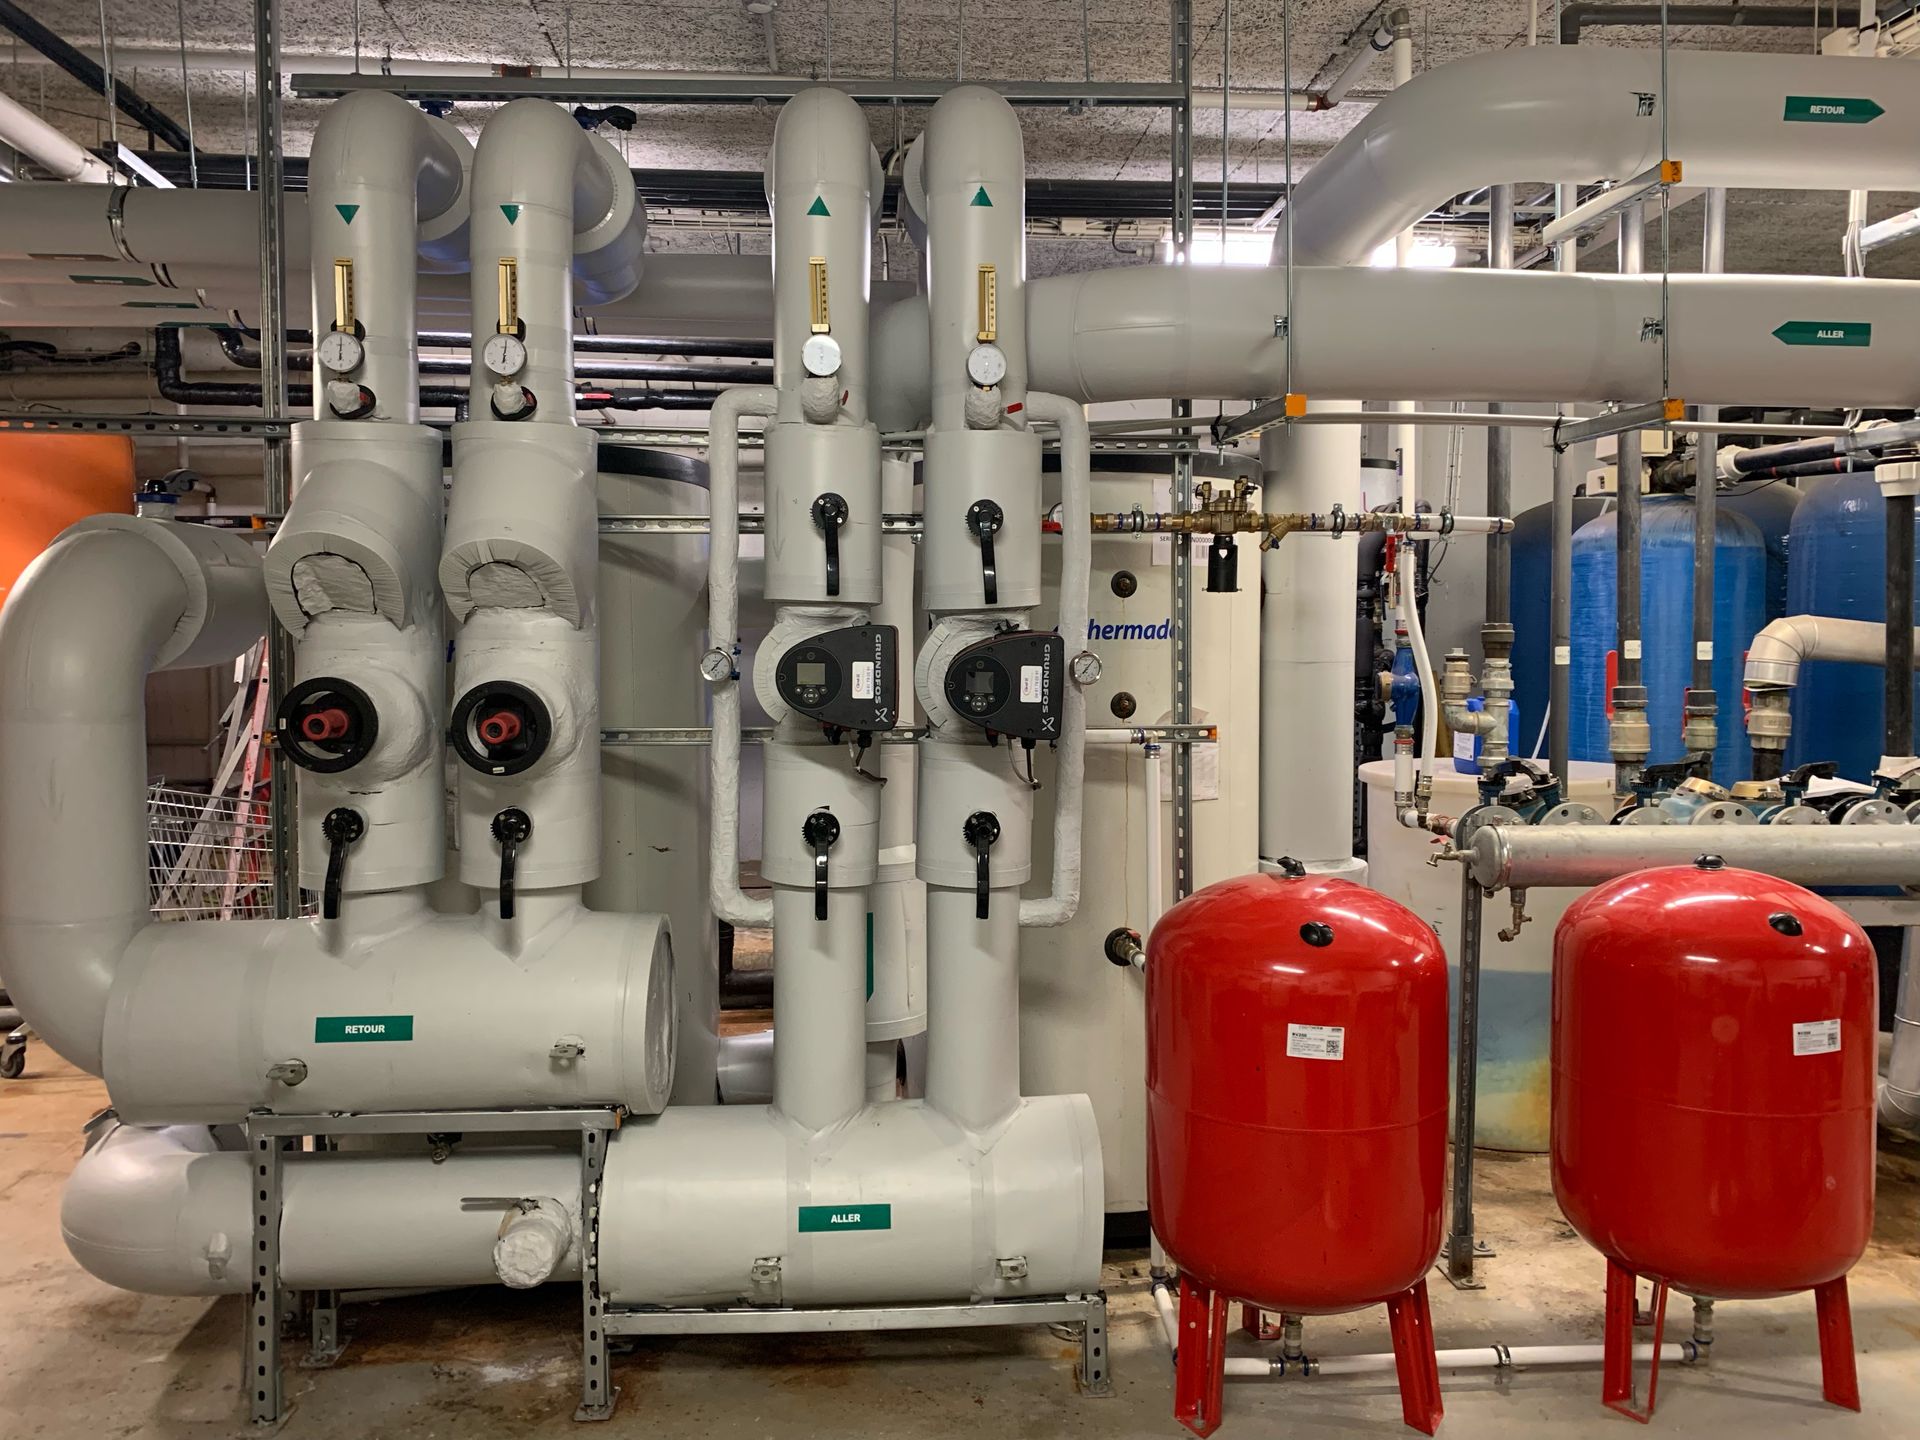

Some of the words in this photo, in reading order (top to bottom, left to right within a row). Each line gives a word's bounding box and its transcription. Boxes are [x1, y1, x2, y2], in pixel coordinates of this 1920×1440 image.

[1810, 105, 1845, 114] RETOUR
[1817, 330, 1844, 338] ALLER
[1087, 618, 1174, 640] hermad
[1042, 644, 1050, 713] GRUNDFOS
[345, 1024, 385, 1034] RETOUR
[830, 1213, 861, 1223] ALLER
